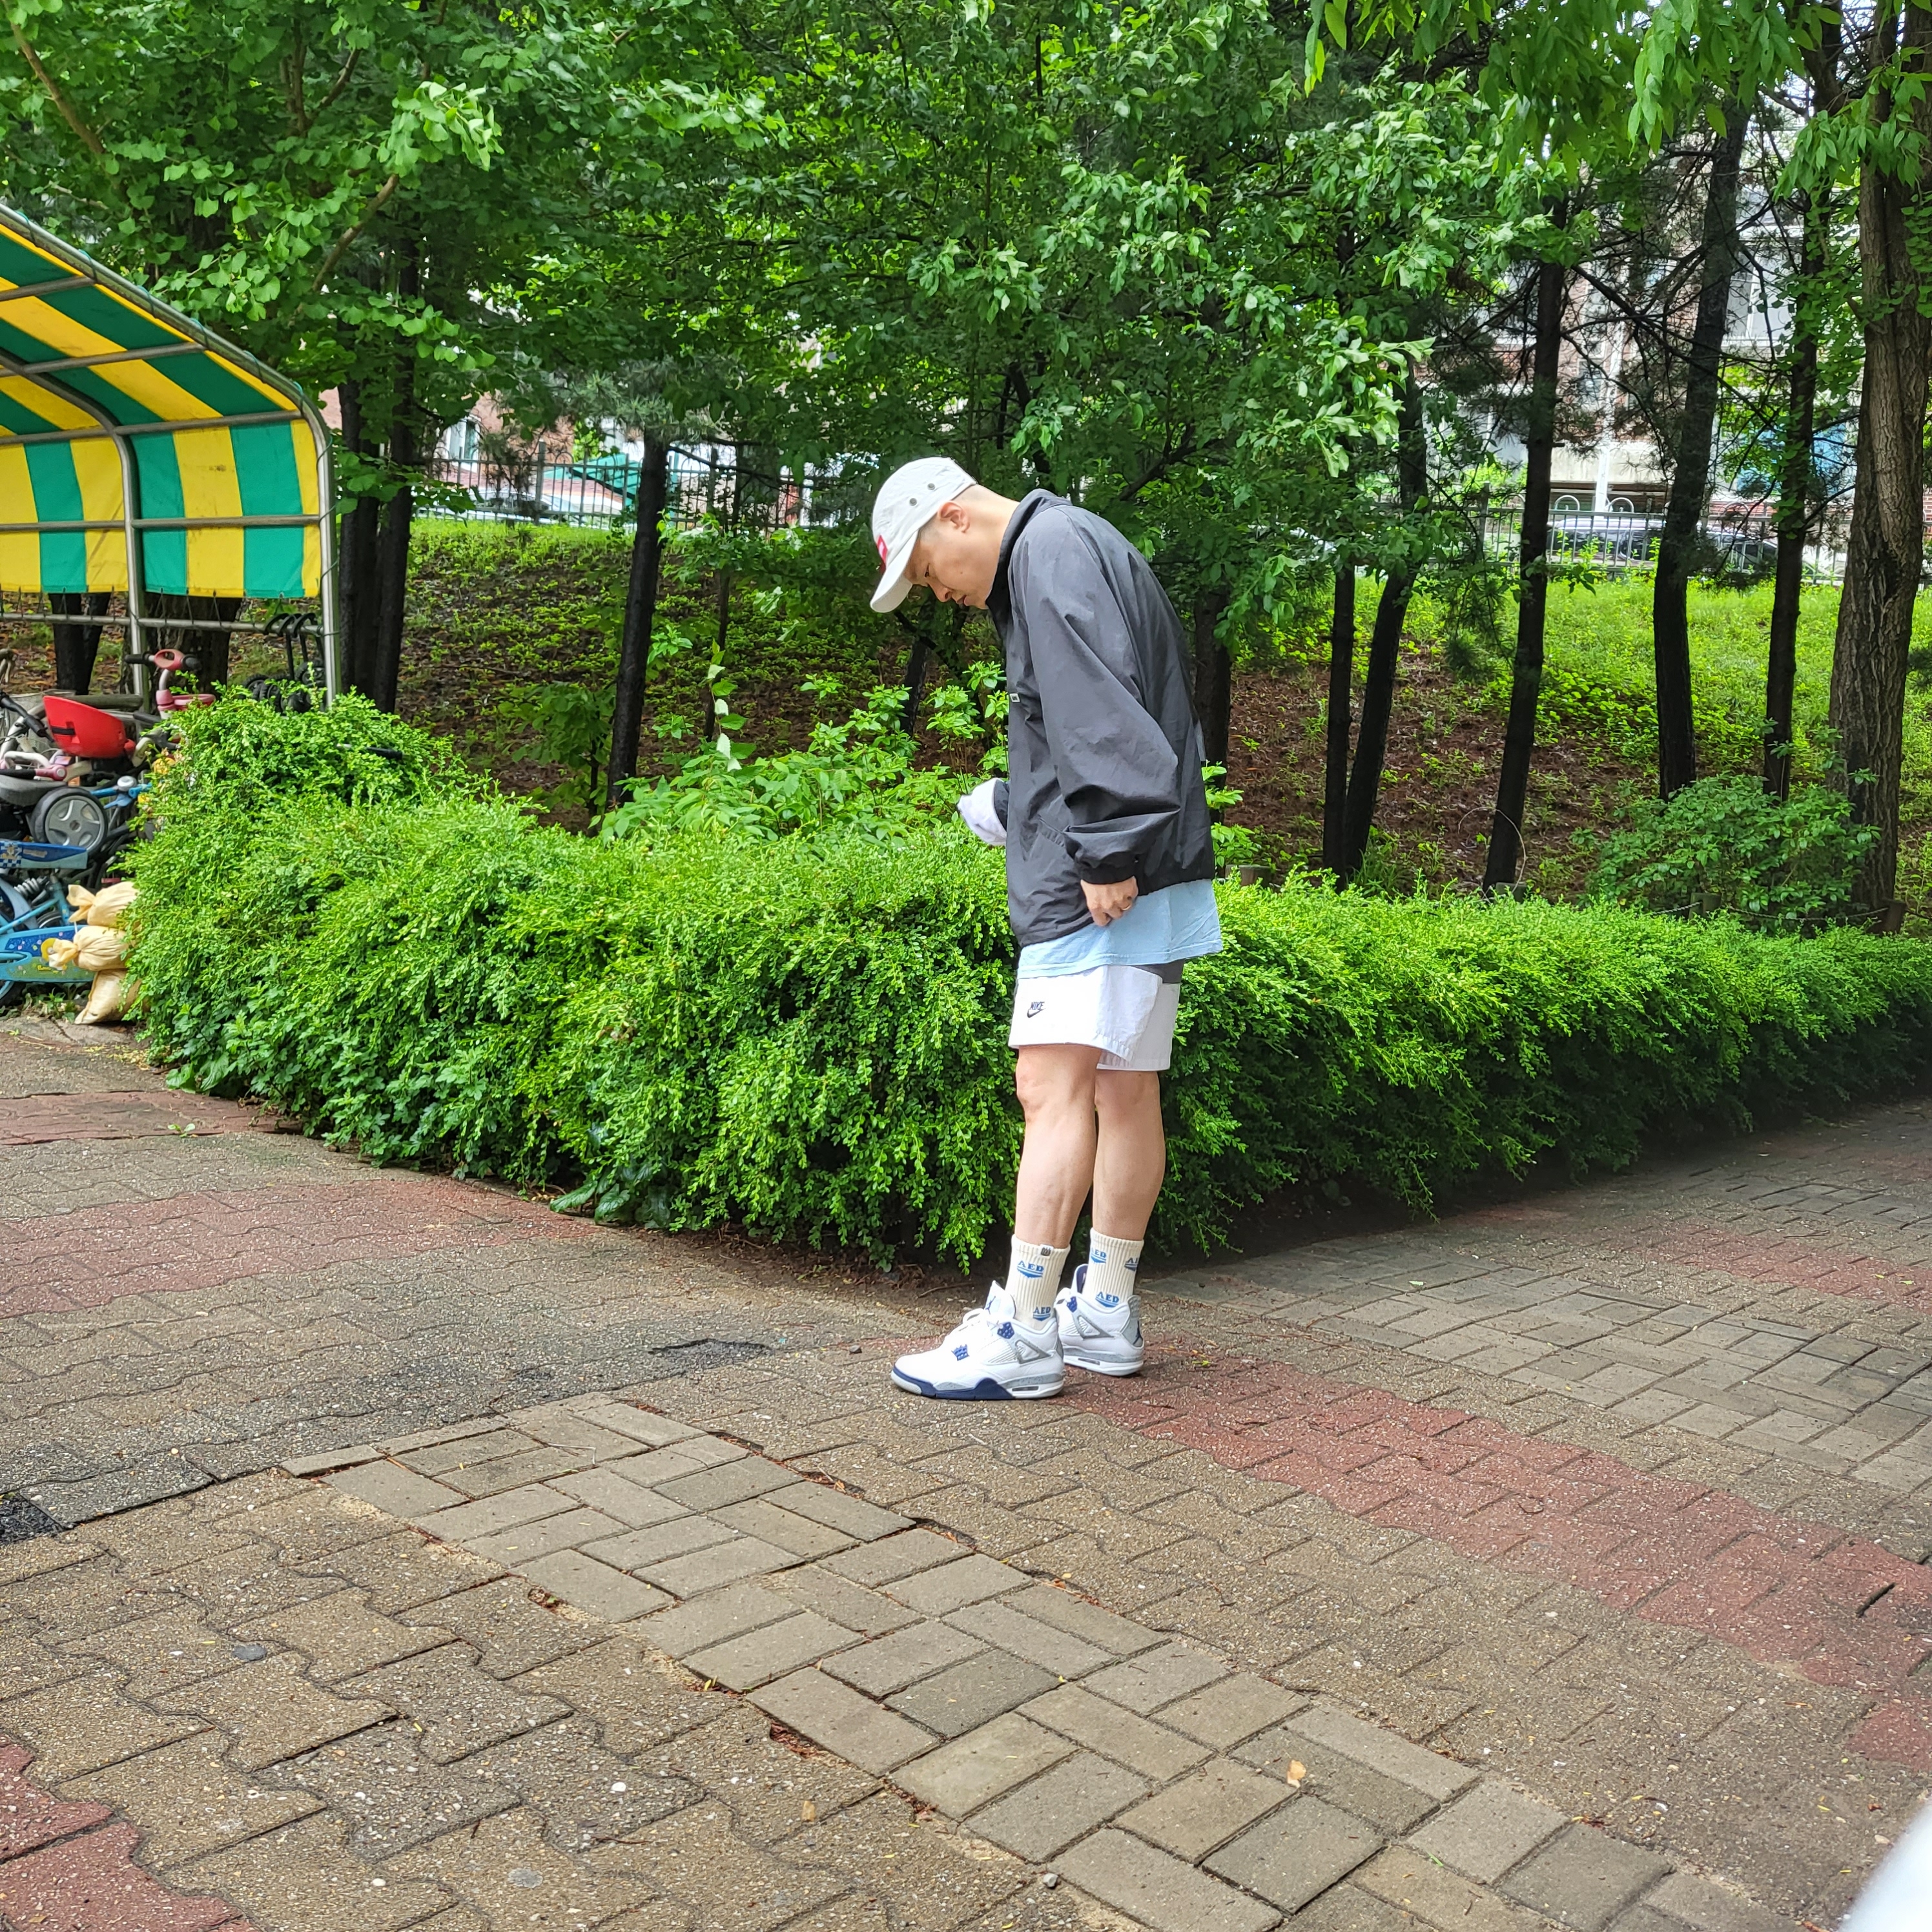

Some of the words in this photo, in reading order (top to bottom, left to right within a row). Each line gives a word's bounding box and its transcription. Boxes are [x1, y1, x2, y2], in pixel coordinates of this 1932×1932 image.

[1031, 1002, 1045, 1010] NIKE
[1018, 1260, 1044, 1271] AED
[1097, 1291, 1120, 1303] AED
[1033, 1306, 1051, 1315] AED
